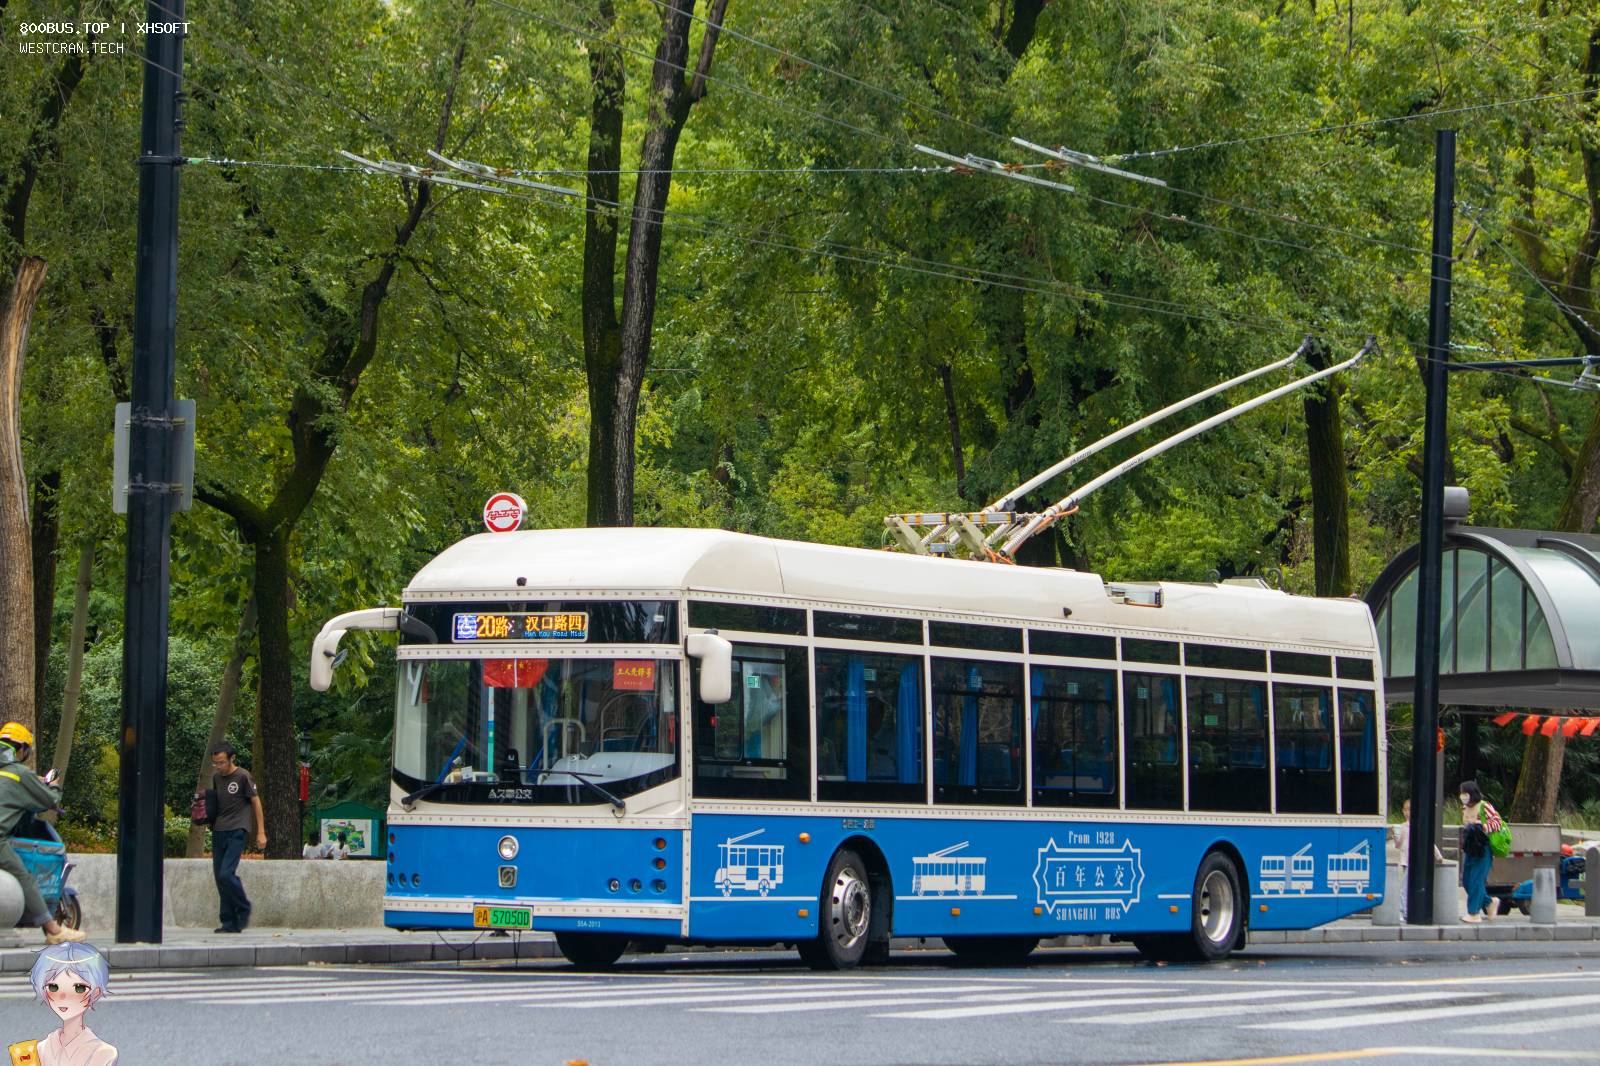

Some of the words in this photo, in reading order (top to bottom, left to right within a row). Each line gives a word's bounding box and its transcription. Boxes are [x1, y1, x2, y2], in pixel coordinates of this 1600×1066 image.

[476, 615, 508, 637] 20路
[525, 615, 586, 631] 汉口路四
[1068, 830, 1090, 844] From
[1096, 831, 1115, 845] 1928
[1056, 864, 1124, 888] 百年公交
[1056, 907, 1097, 920] SHANGHAI
[1105, 907, 1121, 920] BUS
